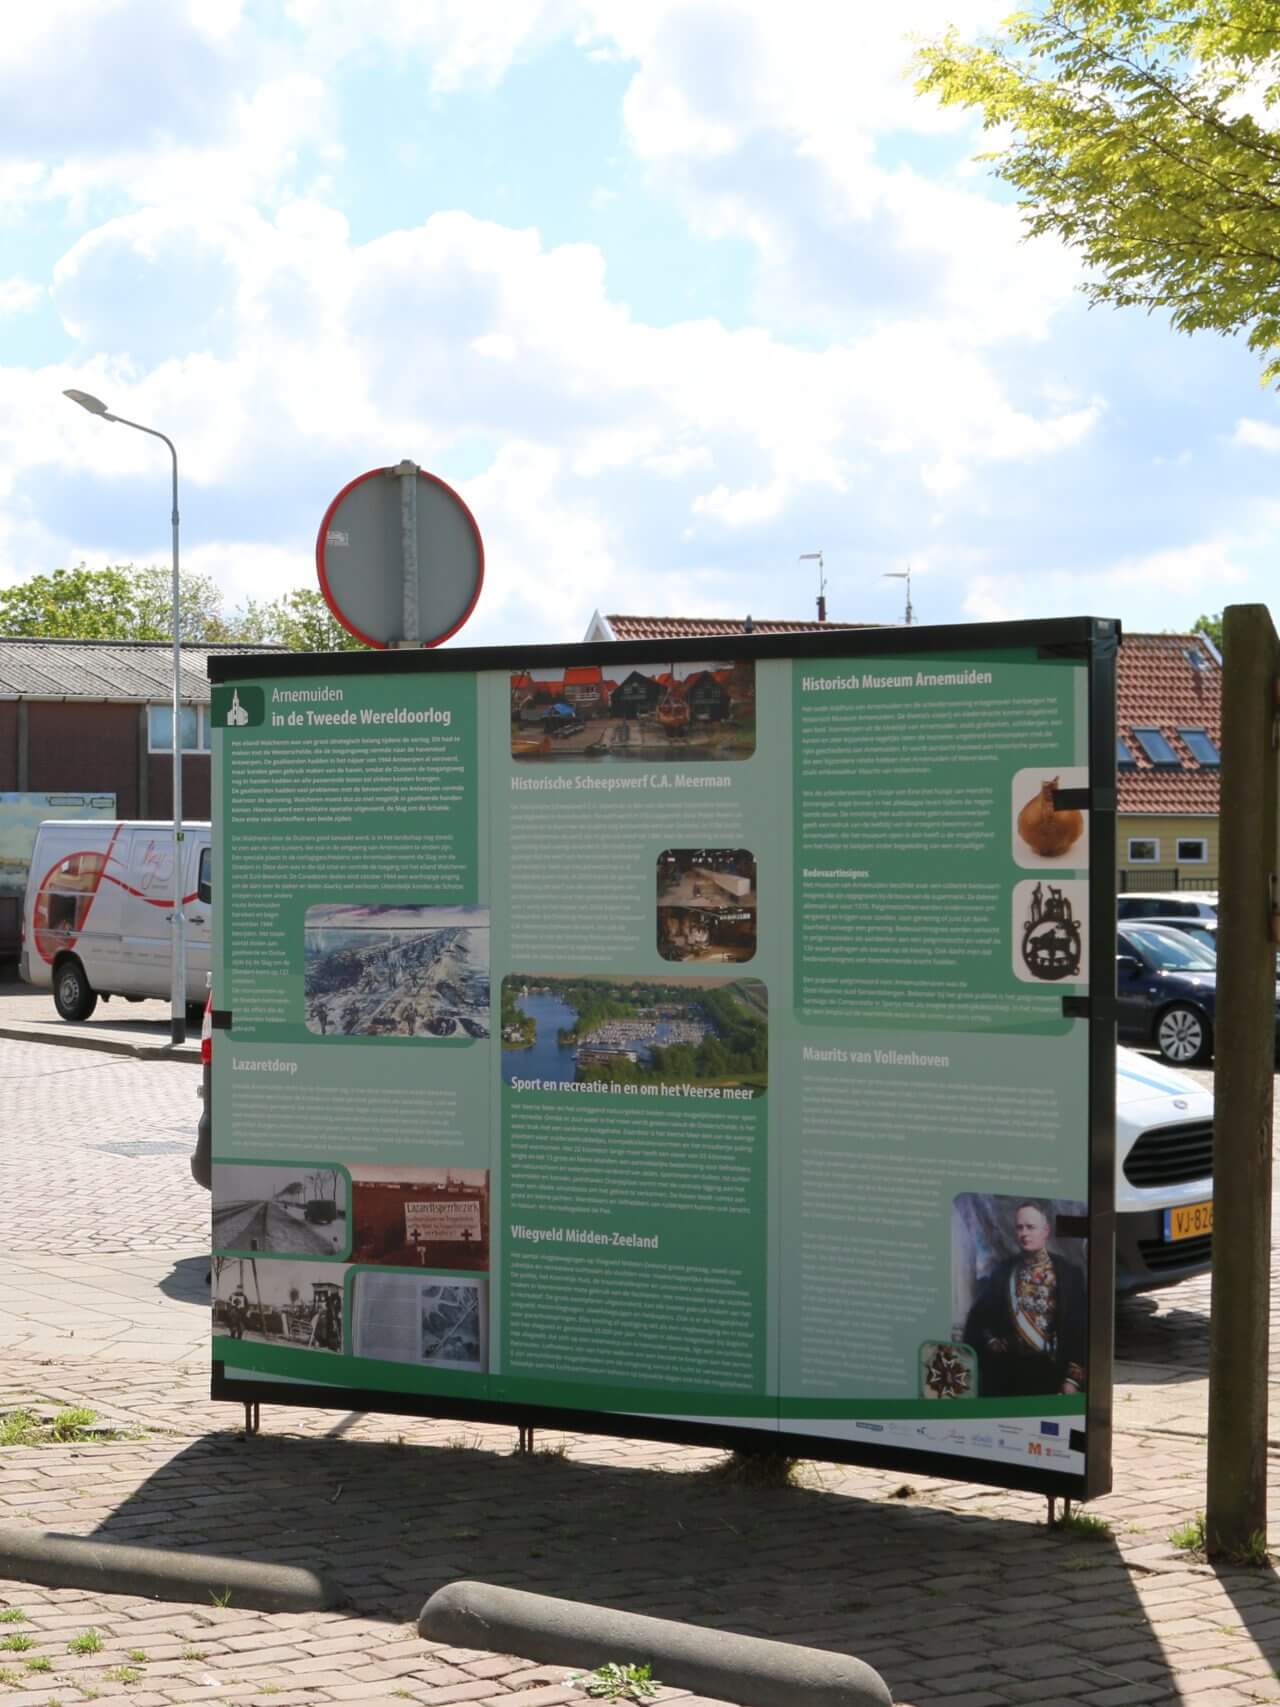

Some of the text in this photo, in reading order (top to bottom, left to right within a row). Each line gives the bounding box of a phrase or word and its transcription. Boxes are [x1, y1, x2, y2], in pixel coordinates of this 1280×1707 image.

[802, 670, 992, 691] Historisch Museum Arnemuiden
[272, 686, 344, 703] Arnemuiden
[272, 707, 452, 726] in de Tweede Wereldoorlog
[511, 773, 731, 793] Historische Scheepswerf C.A. Meerman
[232, 1057, 298, 1075] Lazaretdorp
[803, 1046, 949, 1068] Maurits van Vollenhoven
[511, 1076, 754, 1101] Sport en recreatie in en om het Veerse meer
[511, 1225, 658, 1249] Vliegveld Midden-Zeeland
